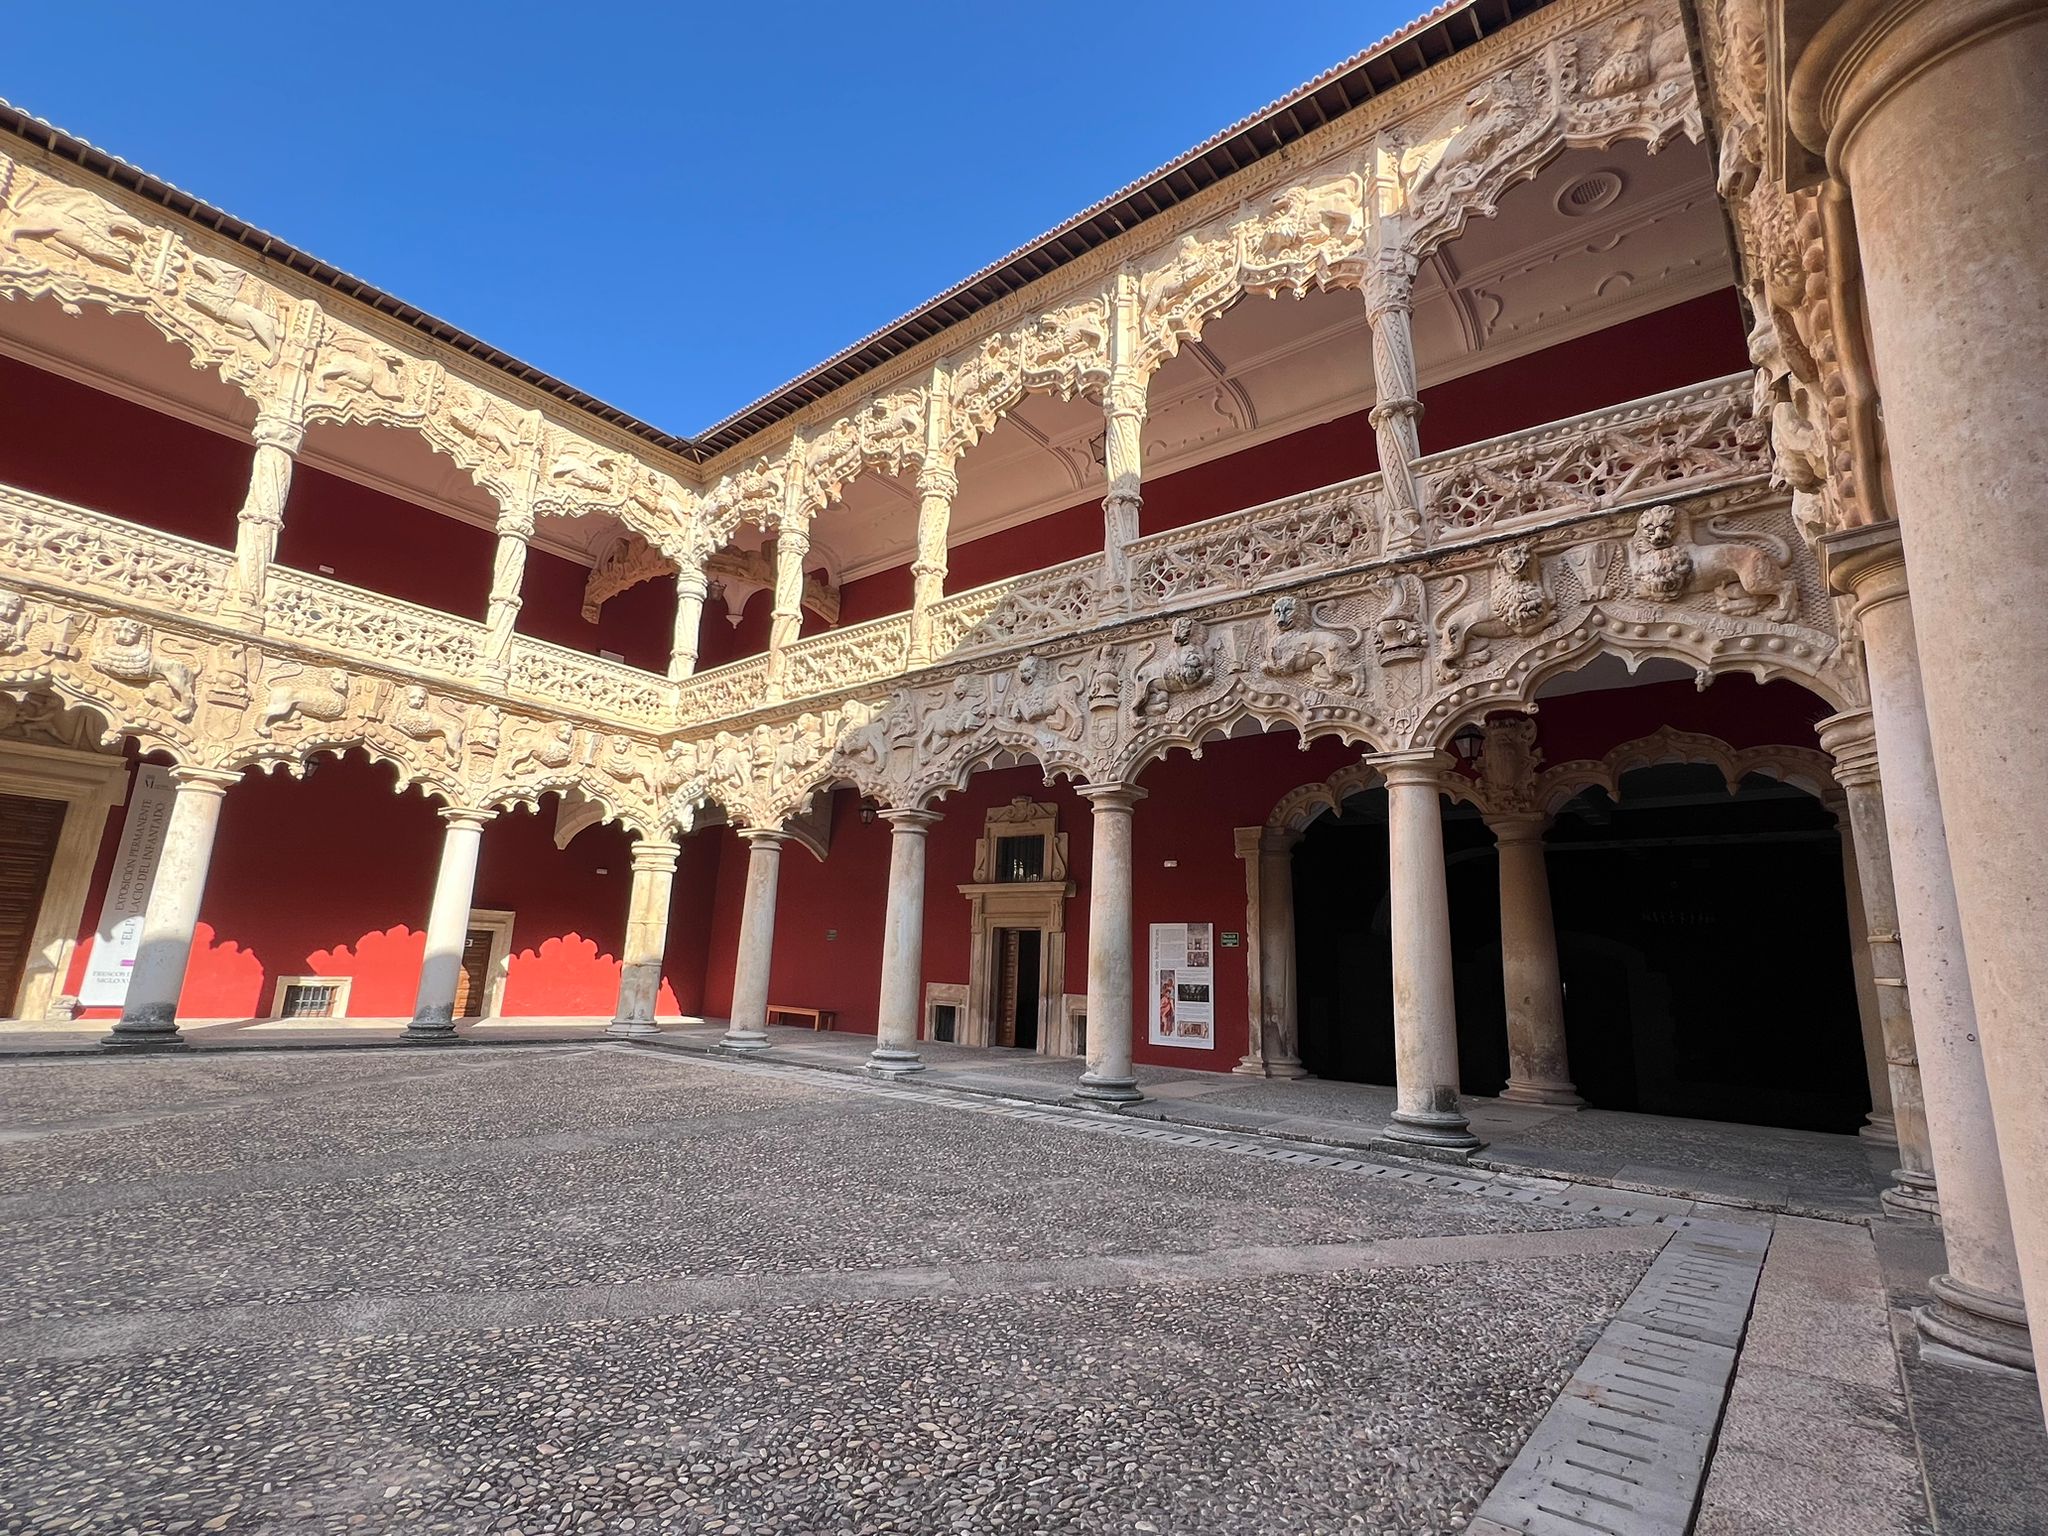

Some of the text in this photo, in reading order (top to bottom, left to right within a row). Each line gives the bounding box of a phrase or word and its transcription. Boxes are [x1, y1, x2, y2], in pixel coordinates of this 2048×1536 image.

[114, 799, 152, 911] EXPOSICIÓN PERMANENTE
[136, 863, 150, 881] DEL
